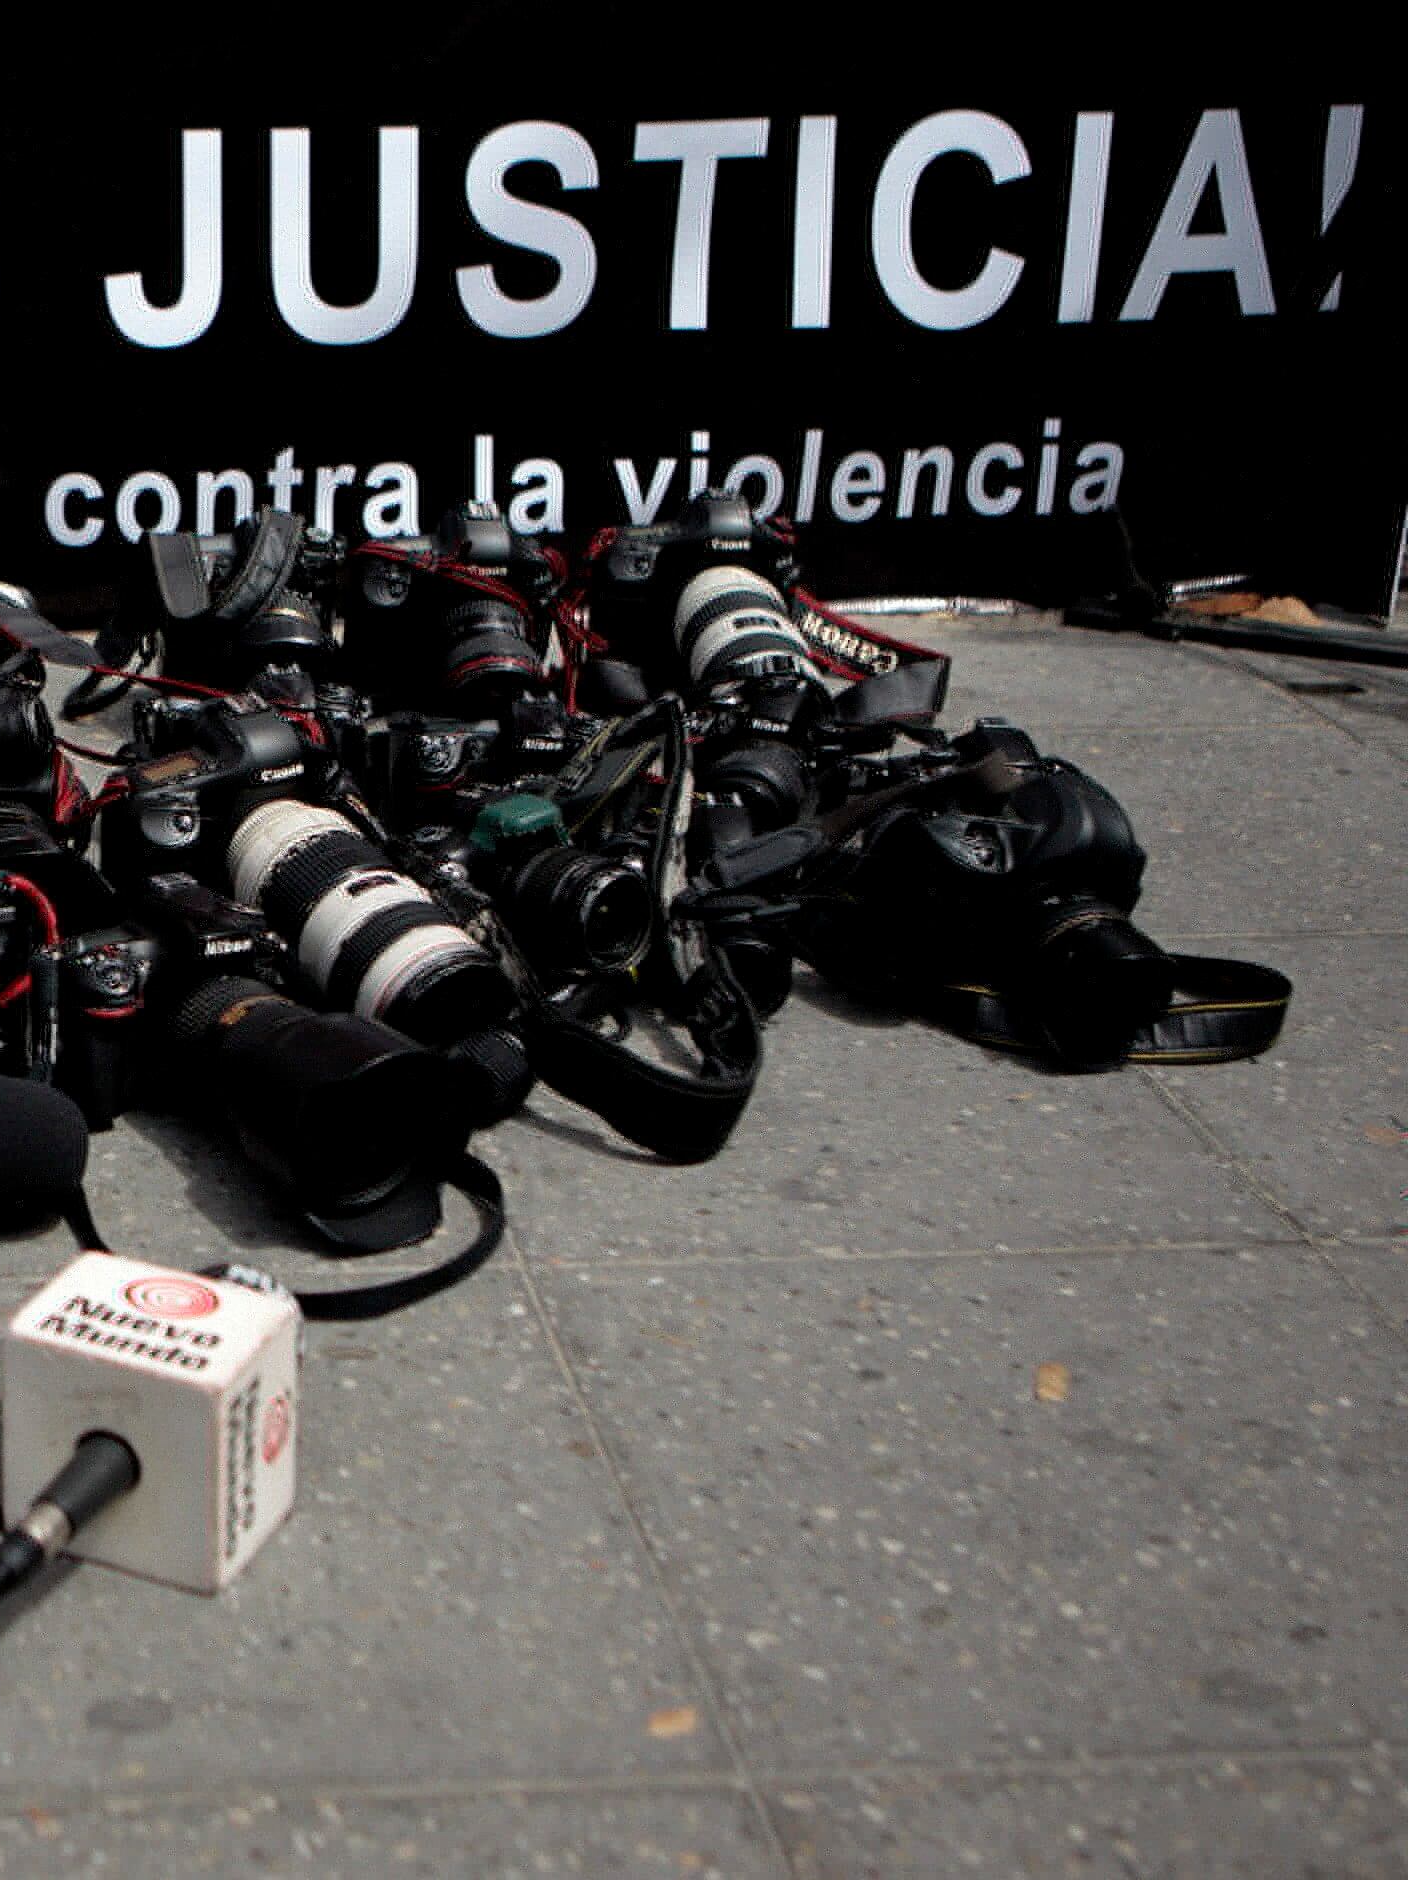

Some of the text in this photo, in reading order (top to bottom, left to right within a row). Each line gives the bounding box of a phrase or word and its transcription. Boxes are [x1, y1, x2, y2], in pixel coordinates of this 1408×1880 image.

[104, 106, 1362, 347] JUSTICIA!
[45, 447, 419, 547] contra
[474, 434, 564, 535] la
[614, 418, 1123, 525] violencia
